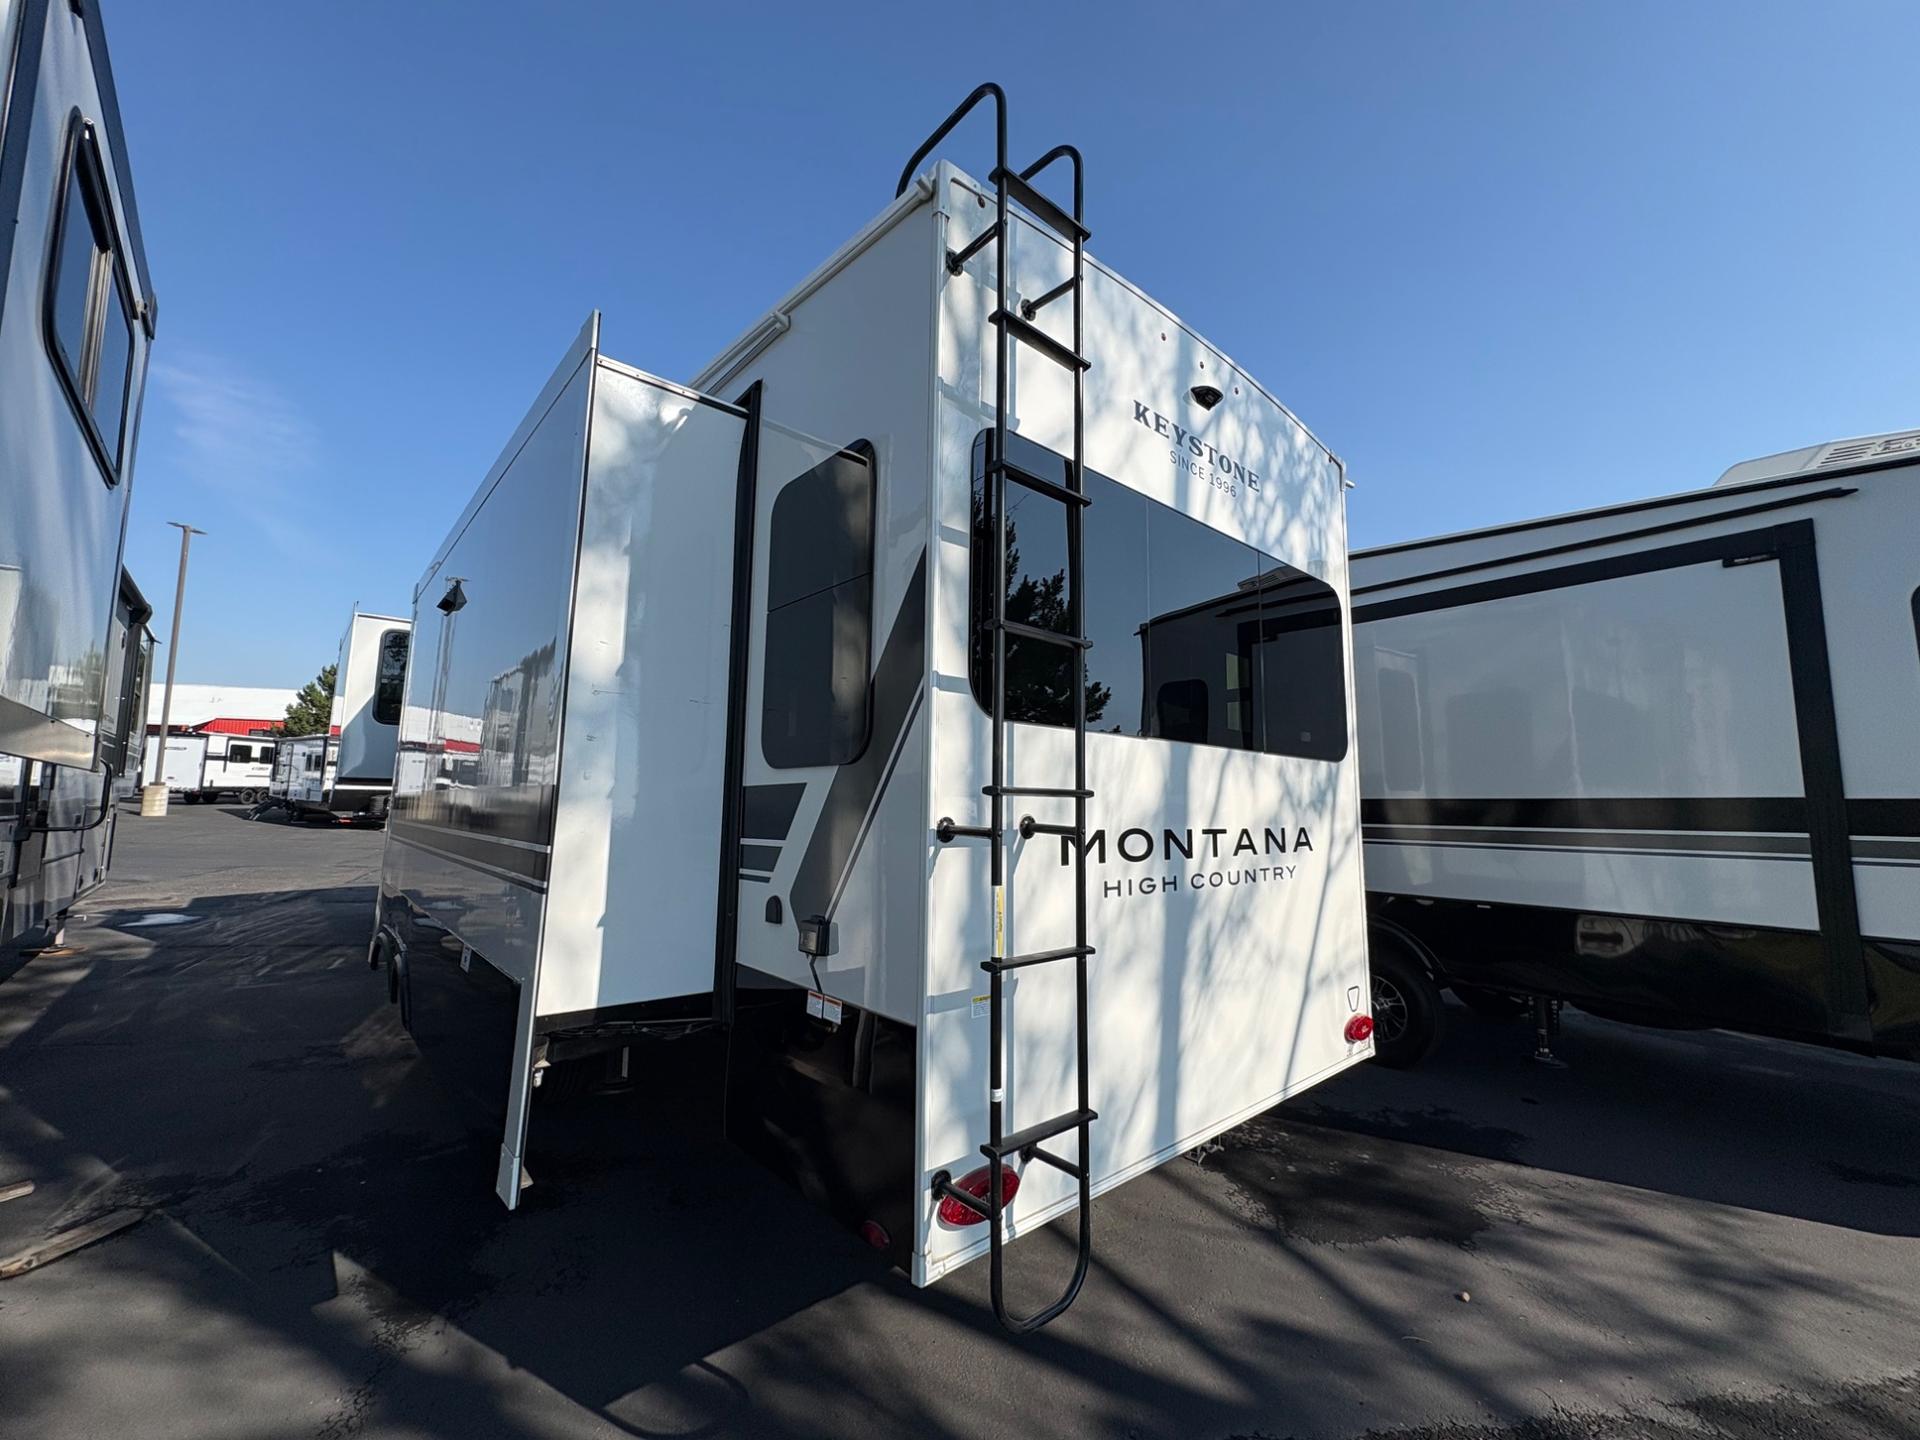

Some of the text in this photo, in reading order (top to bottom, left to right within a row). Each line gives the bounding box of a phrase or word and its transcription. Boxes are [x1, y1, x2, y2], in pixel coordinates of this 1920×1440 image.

[1133, 400, 1260, 492] KEYSTONE
[1169, 450, 1236, 498] SINCE 1996
[1060, 827, 1314, 866] MONTANA
[1103, 865, 1297, 898] HIGH COUNTRY
